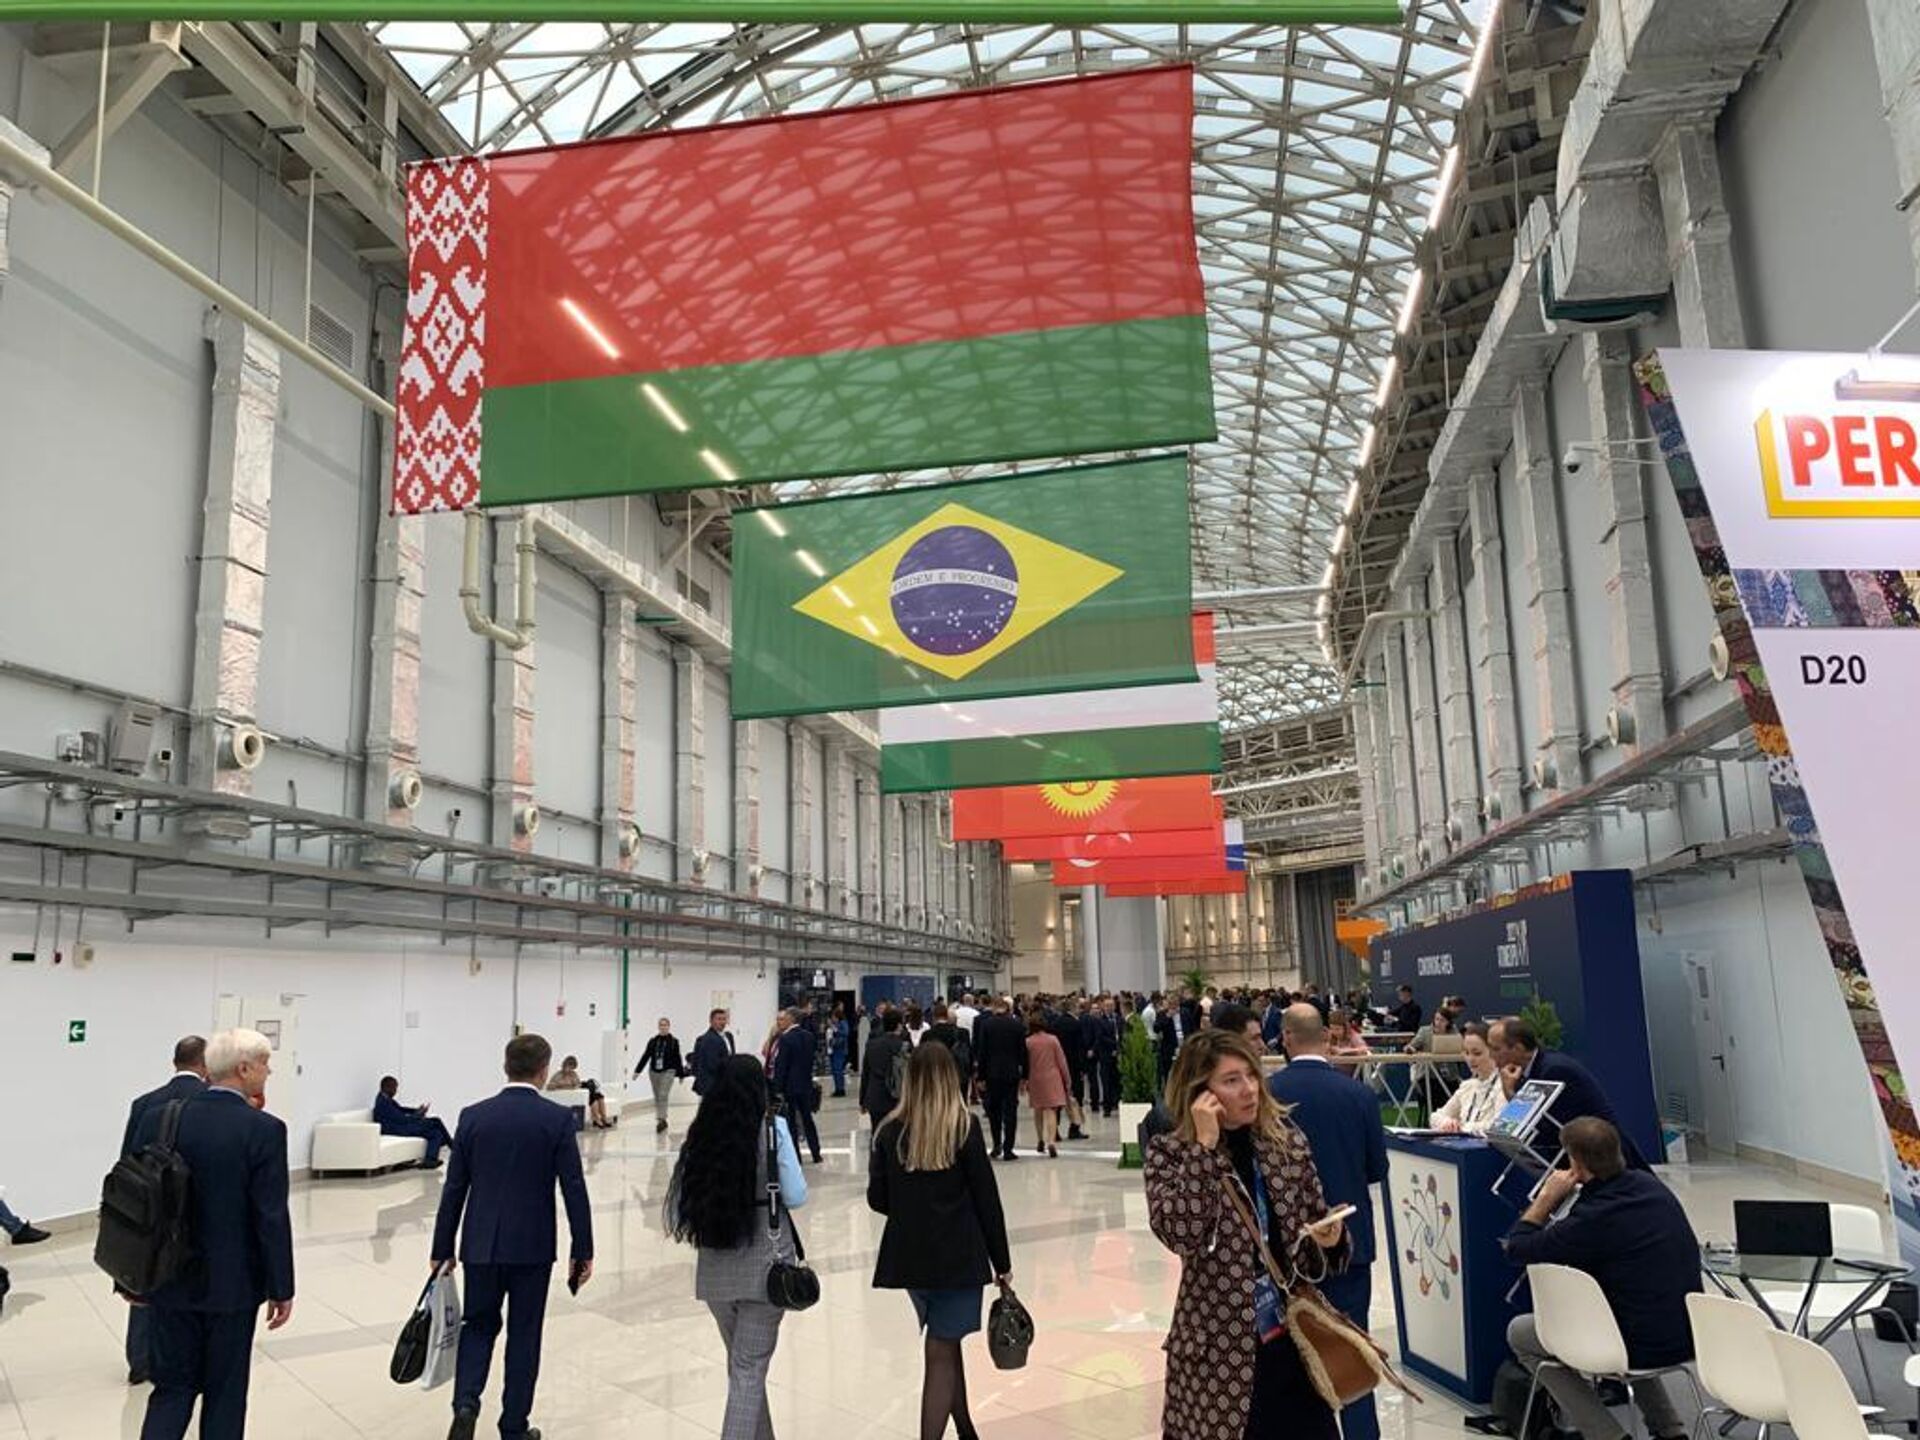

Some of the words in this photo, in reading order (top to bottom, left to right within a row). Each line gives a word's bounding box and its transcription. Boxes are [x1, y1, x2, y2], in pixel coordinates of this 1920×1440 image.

[894, 573, 933, 591] ORDEM
[938, 572, 946, 582] E
[953, 572, 1015, 591] PROGRESSO
[1800, 655, 1867, 685] D20
